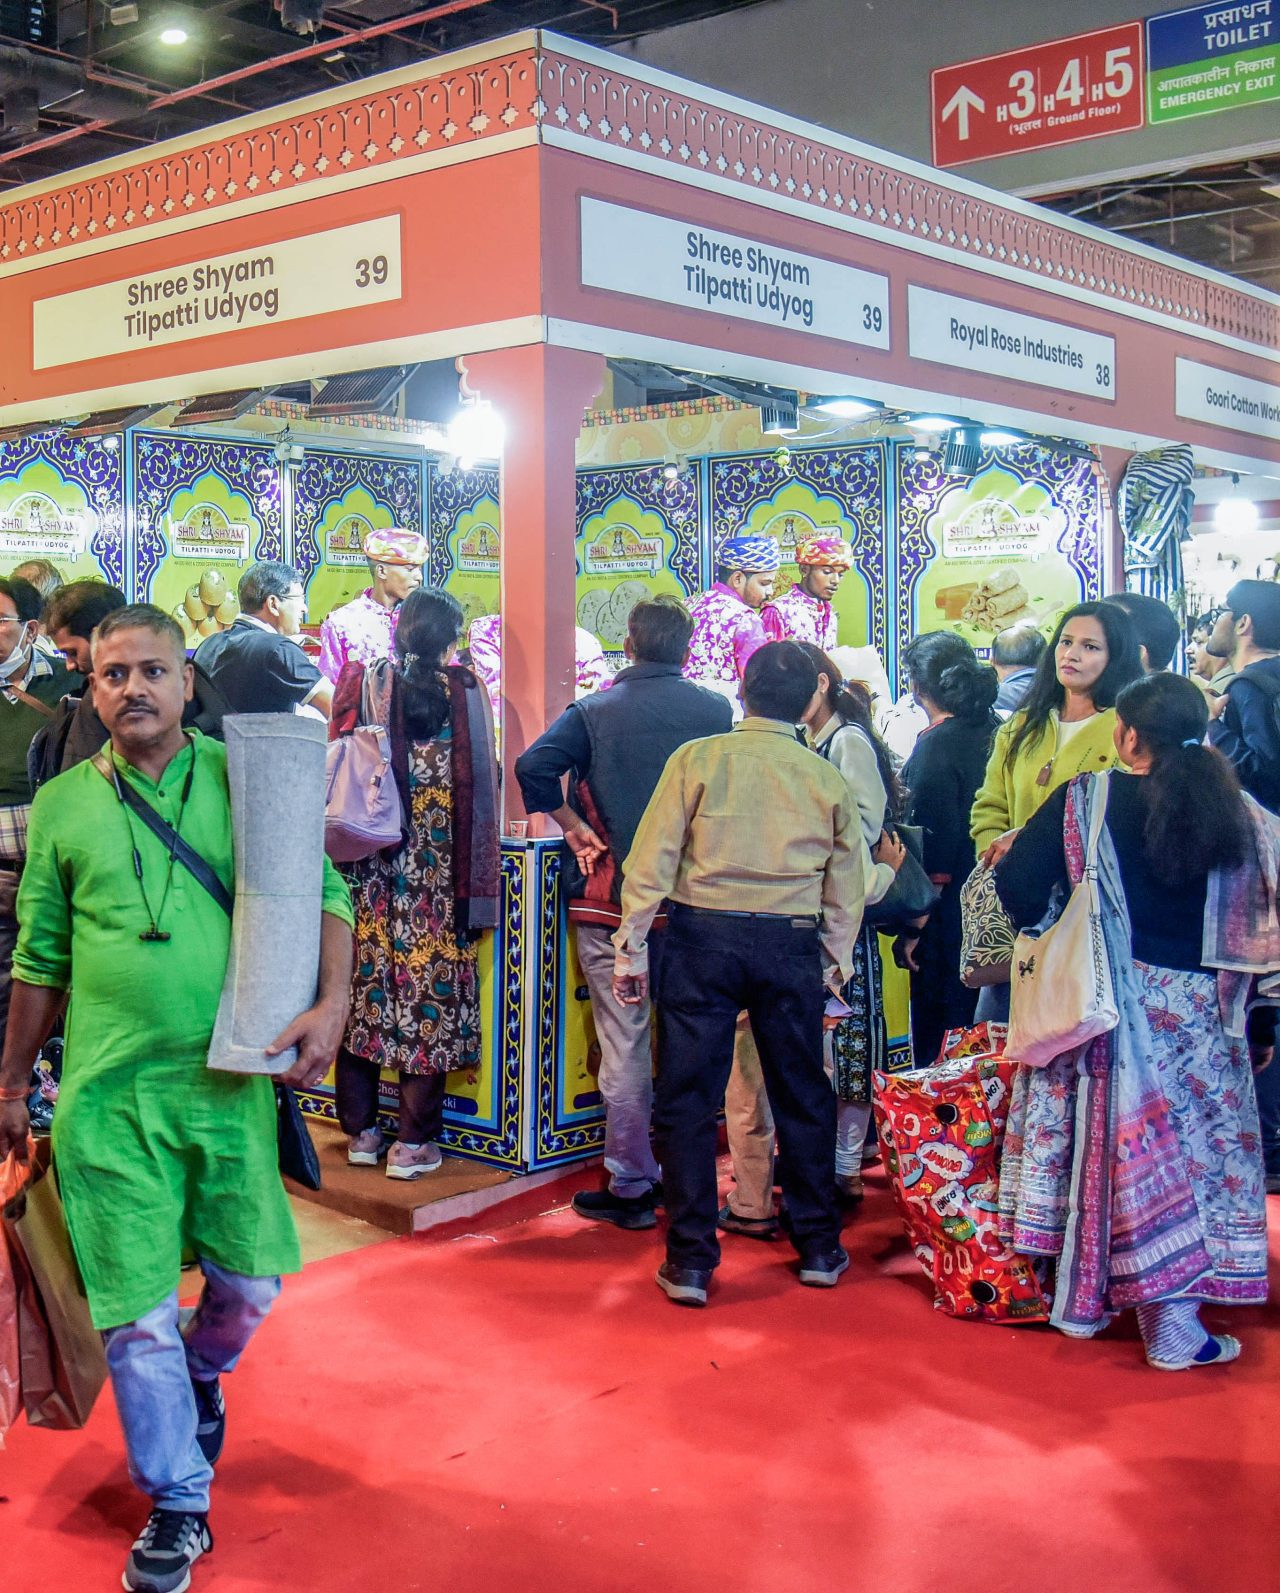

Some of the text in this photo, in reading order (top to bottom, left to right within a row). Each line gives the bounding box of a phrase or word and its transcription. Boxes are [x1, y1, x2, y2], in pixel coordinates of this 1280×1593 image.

[1203, 0, 1271, 29] प्रसाधन
[1203, 21, 1272, 50] TOILET
[1157, 57, 1276, 91] आपातकालीन निकास
[1160, 74, 1276, 109] EMERGENCY EXIT
[1047, 111, 1085, 127] Ground
[1088, 103, 1121, 117] Floor)
[355, 256, 387, 287] 39
[687, 232, 810, 285] Shree Shyam
[128, 256, 274, 307] Shree Shyam
[684, 265, 812, 326] Tilpatti Udyog
[124, 288, 279, 340] Tilpatti Udyog
[862, 303, 882, 333] 39
[950, 317, 1084, 369] Royal Rose Industries
[1095, 363, 1110, 387] 38
[1205, 387, 1229, 409] Goori
[1231, 393, 1259, 417] Cotton
[1, 517, 23, 529] SHRI
[177, 526, 244, 539] SHRI SHYAM
[949, 526, 973, 537] SHRI
[44, 540, 69, 548] UDYOG
[181, 546, 210, 554] TILPATTI
[329, 536, 345, 546] SHRI
[590, 542, 656, 556] SHRI SHYAM
